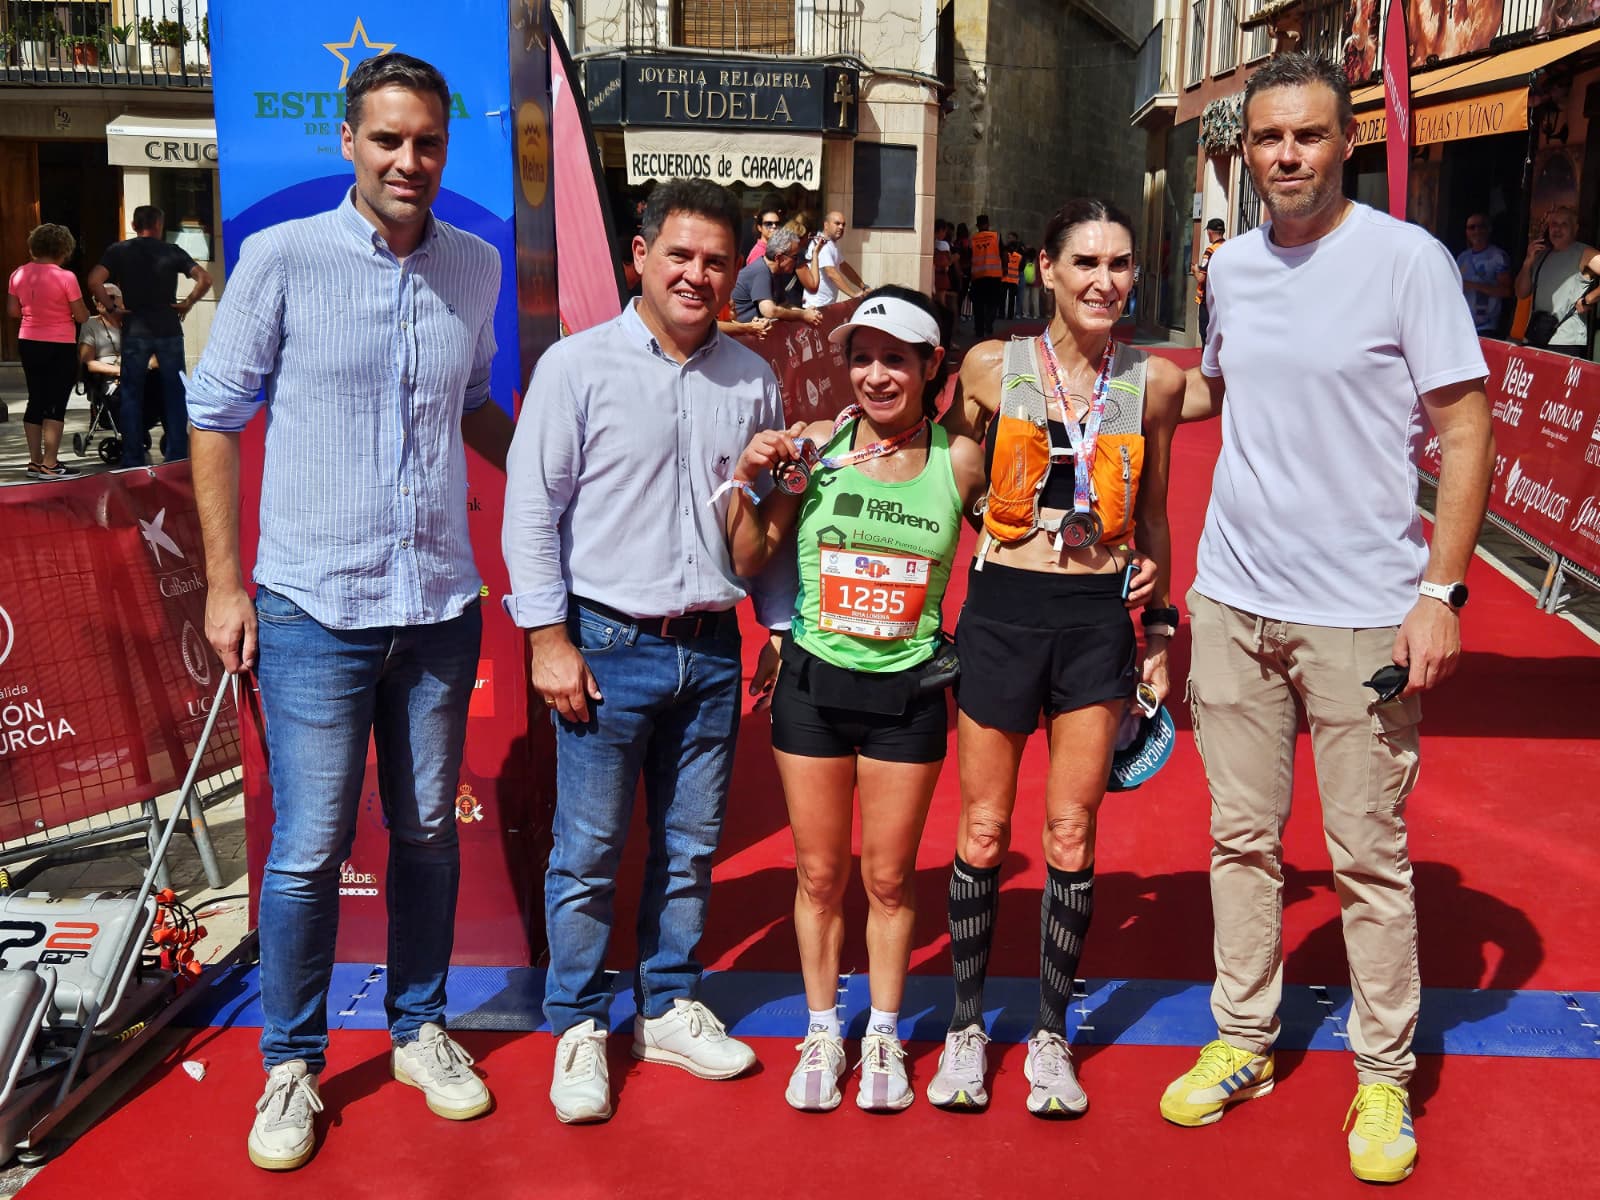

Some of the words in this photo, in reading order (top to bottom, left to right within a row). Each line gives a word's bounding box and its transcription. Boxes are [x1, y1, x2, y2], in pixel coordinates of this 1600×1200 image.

[638, 67, 706, 86] JOYERIA
[719, 70, 812, 89] RELOJERIA
[656, 88, 793, 122] TUDELA
[1467, 102, 1505, 133] VINO
[632, 154, 711, 178] RECUERDOS
[717, 155, 733, 177] de
[742, 155, 814, 182] CARAVACA
[1501, 356, 1535, 399] Vélez
[1502, 399, 1524, 427] Ortiz
[1539, 400, 1584, 432] CANTALAR
[866, 497, 902, 514] pan
[869, 508, 940, 534] moreno
[852, 529, 894, 546] HOGAR
[838, 585, 905, 615] 1235
[339, 872, 377, 884] ERDES
